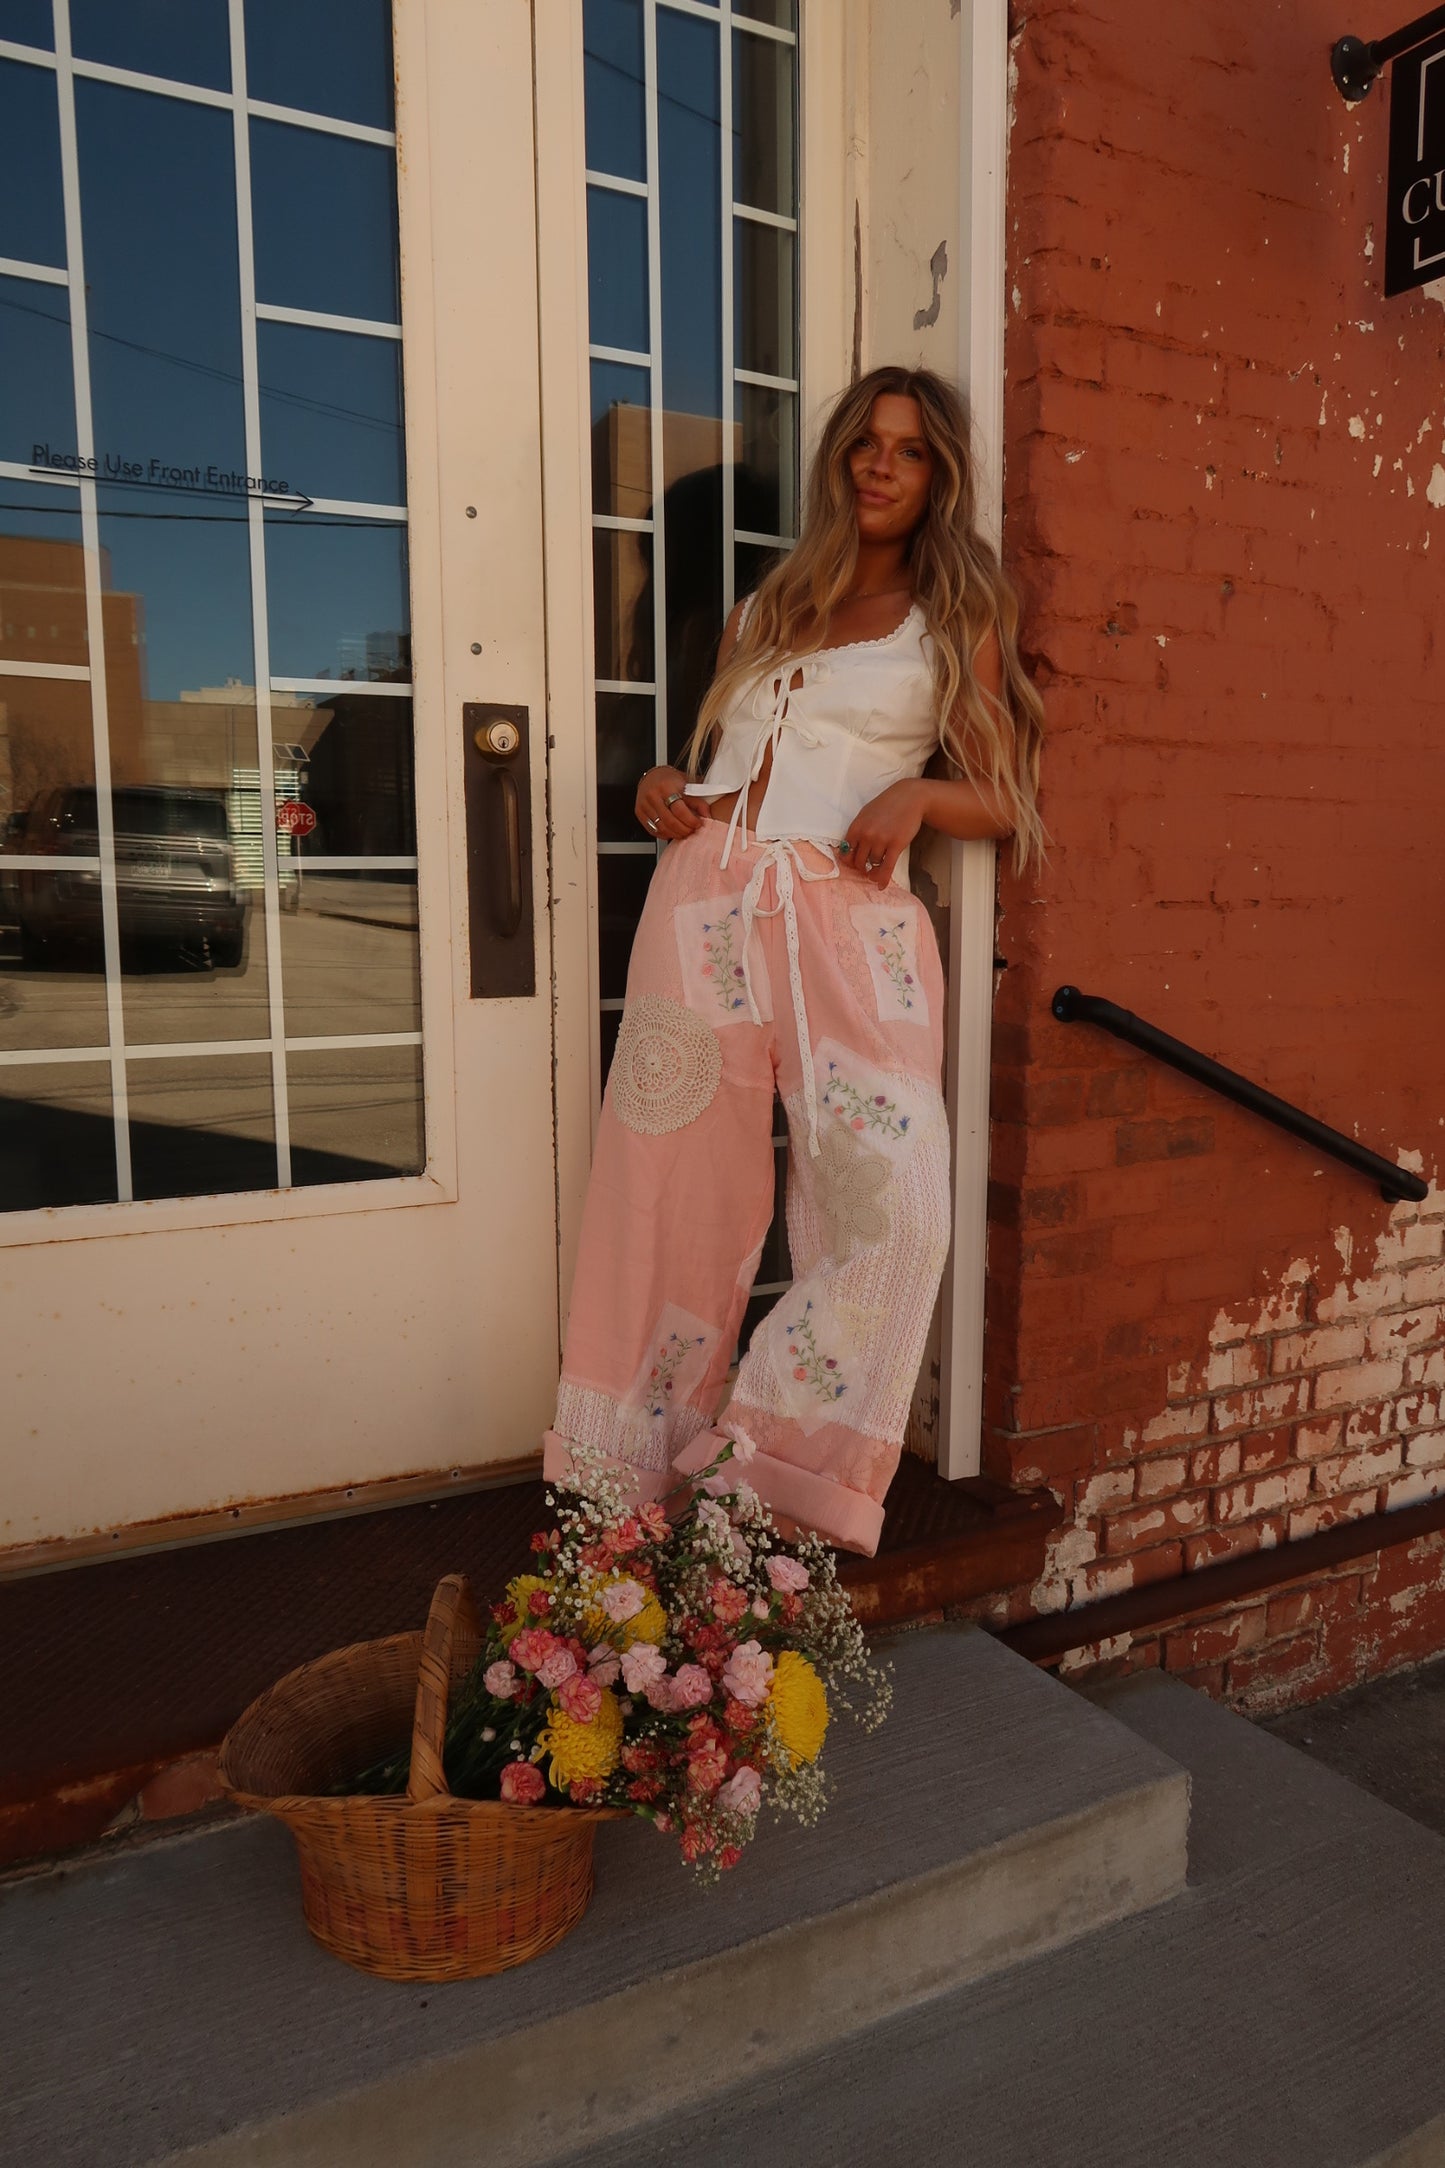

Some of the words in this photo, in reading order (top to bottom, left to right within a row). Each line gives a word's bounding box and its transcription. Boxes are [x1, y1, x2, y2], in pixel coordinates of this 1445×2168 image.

[33, 444, 98, 471] Please
[105, 453, 143, 477] Use
[150, 458, 200, 483] Front
[207, 465, 289, 493] Entrance
